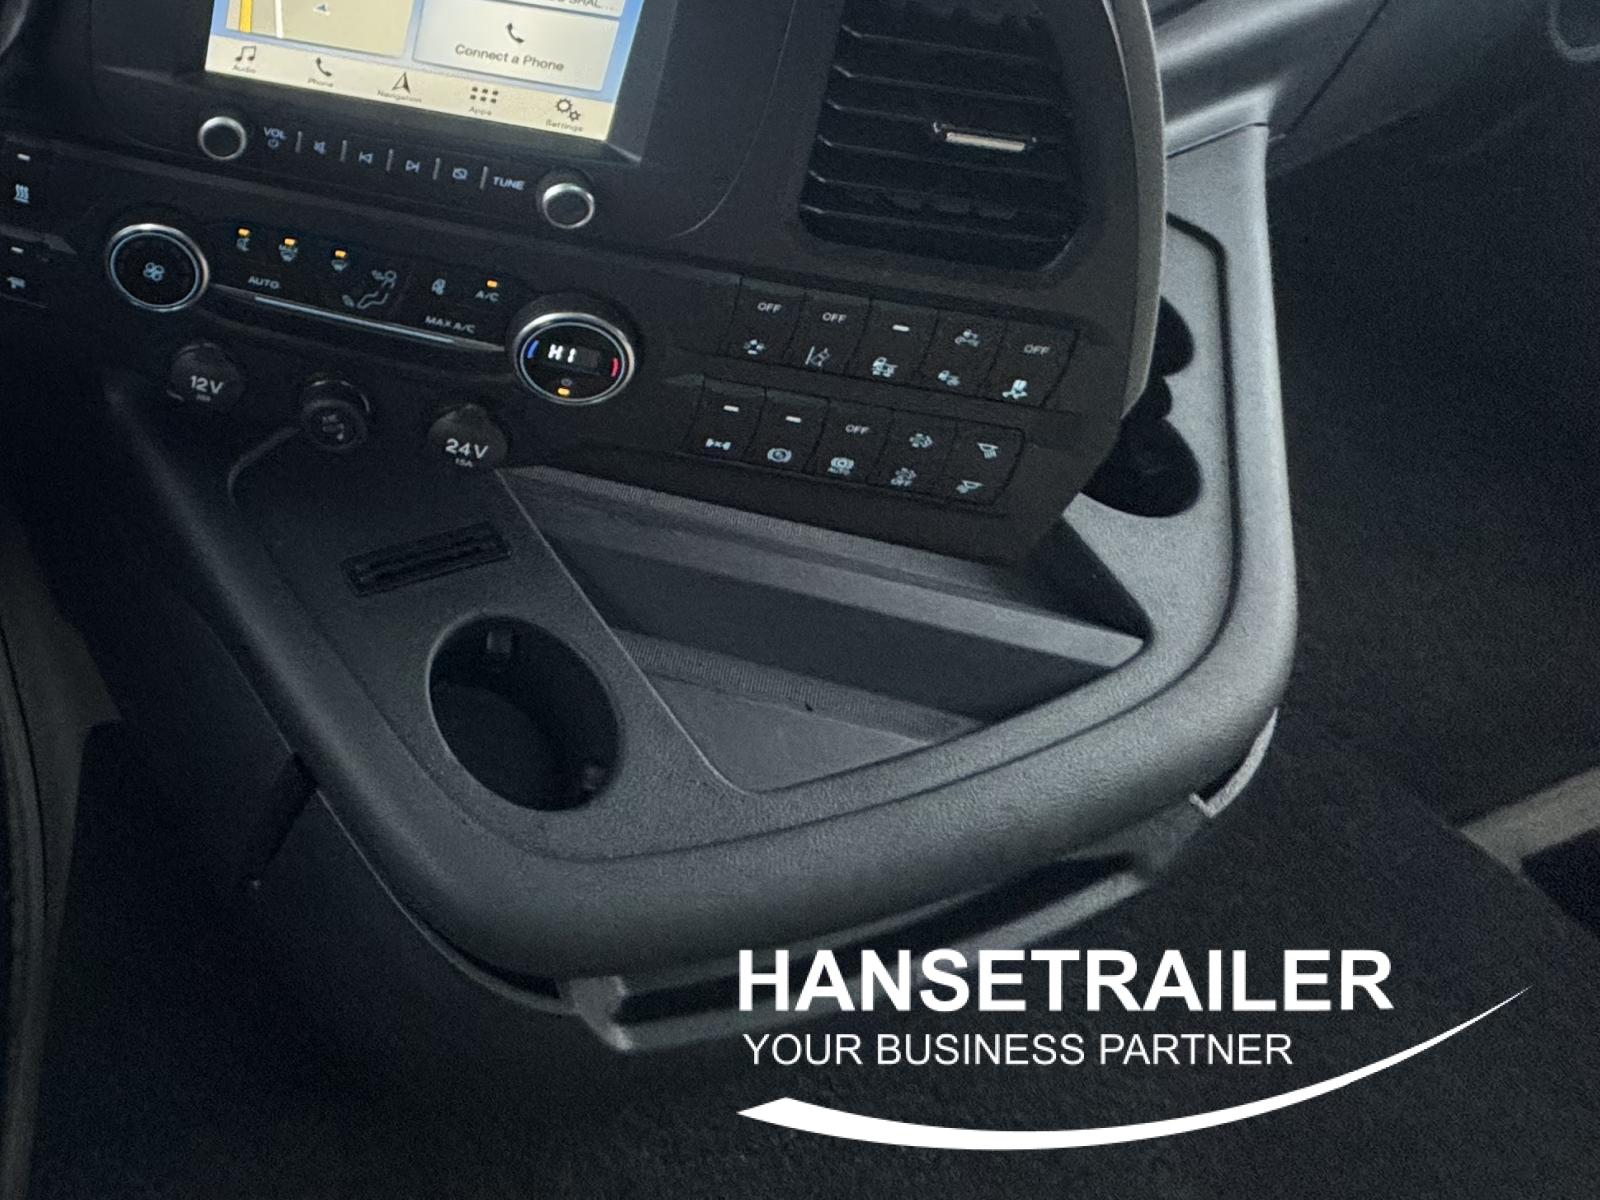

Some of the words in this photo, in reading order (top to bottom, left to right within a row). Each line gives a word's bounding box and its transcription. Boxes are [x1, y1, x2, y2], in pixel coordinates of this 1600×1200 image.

[454, 43, 509, 64] Connect
[511, 54, 520, 65] a
[522, 53, 565, 72] Phone
[263, 126, 288, 141] VOL
[492, 175, 526, 192] TUNE
[248, 275, 280, 290] AUTO
[475, 290, 500, 303] A/C
[757, 301, 782, 314] OFF
[425, 315, 452, 329] MAX
[453, 321, 476, 335] A/C
[822, 311, 848, 324] OFF
[1023, 343, 1051, 356] OFF
[189, 374, 225, 395] 12V
[845, 423, 871, 436] OFF
[445, 438, 489, 460] 24V
